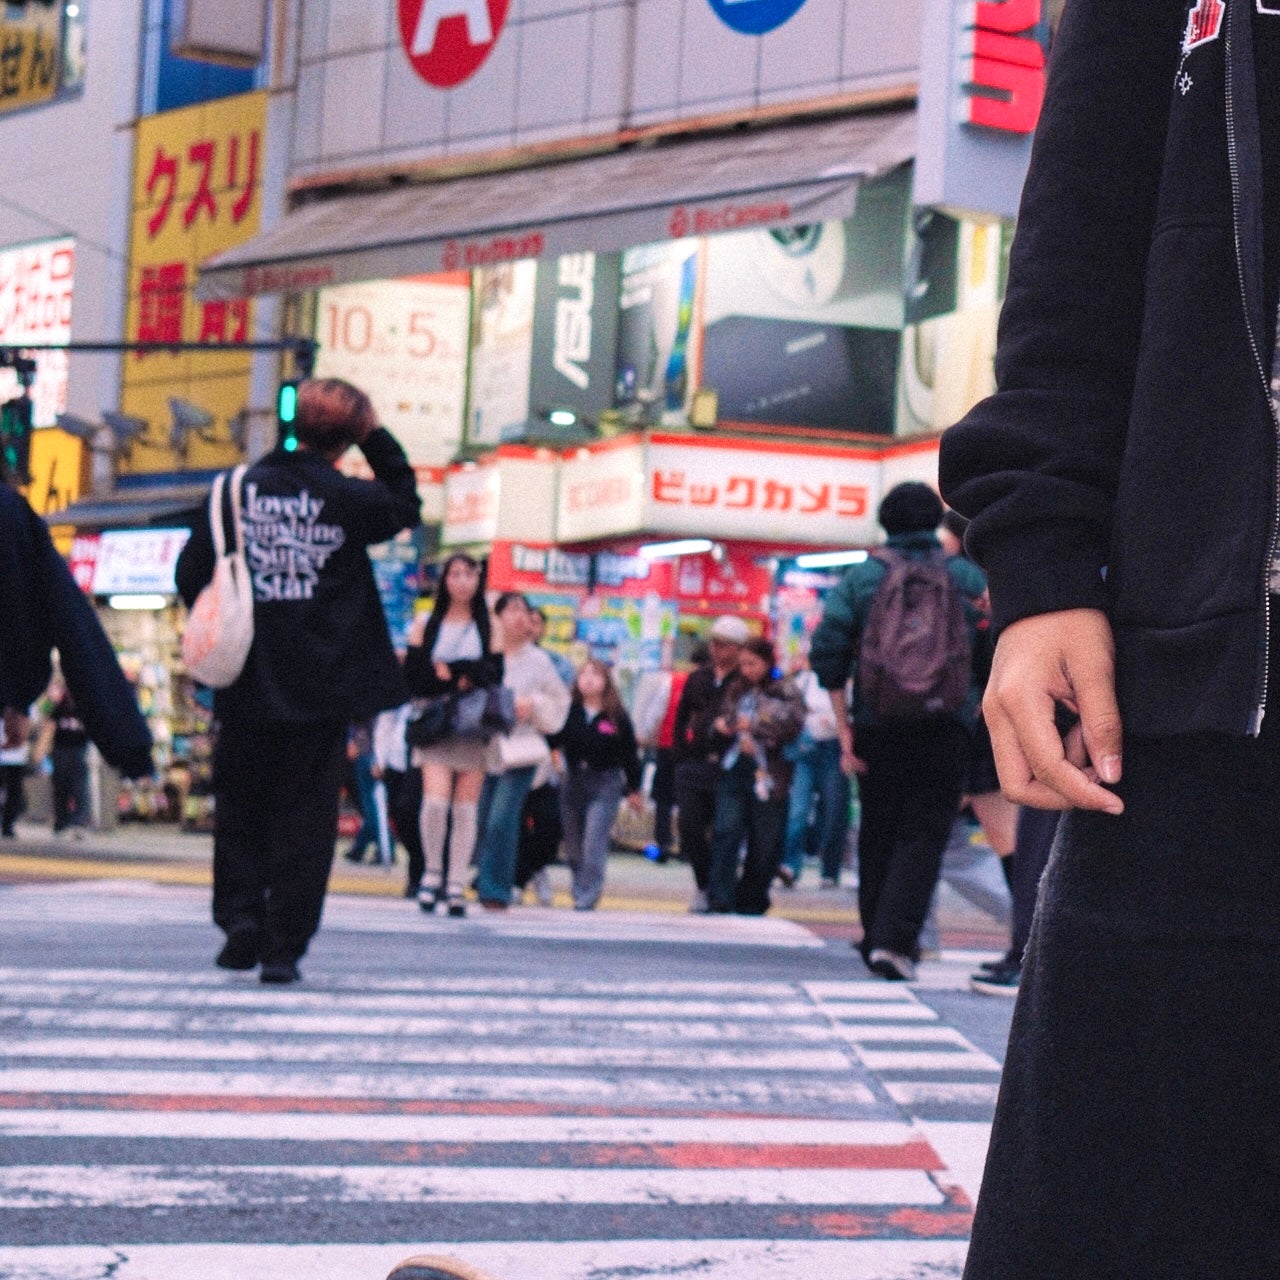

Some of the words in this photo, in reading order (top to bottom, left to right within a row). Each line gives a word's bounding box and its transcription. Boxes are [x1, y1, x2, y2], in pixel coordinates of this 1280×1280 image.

[146, 128, 259, 239] クスリ
[652, 469, 869, 519] ビックカメラ
